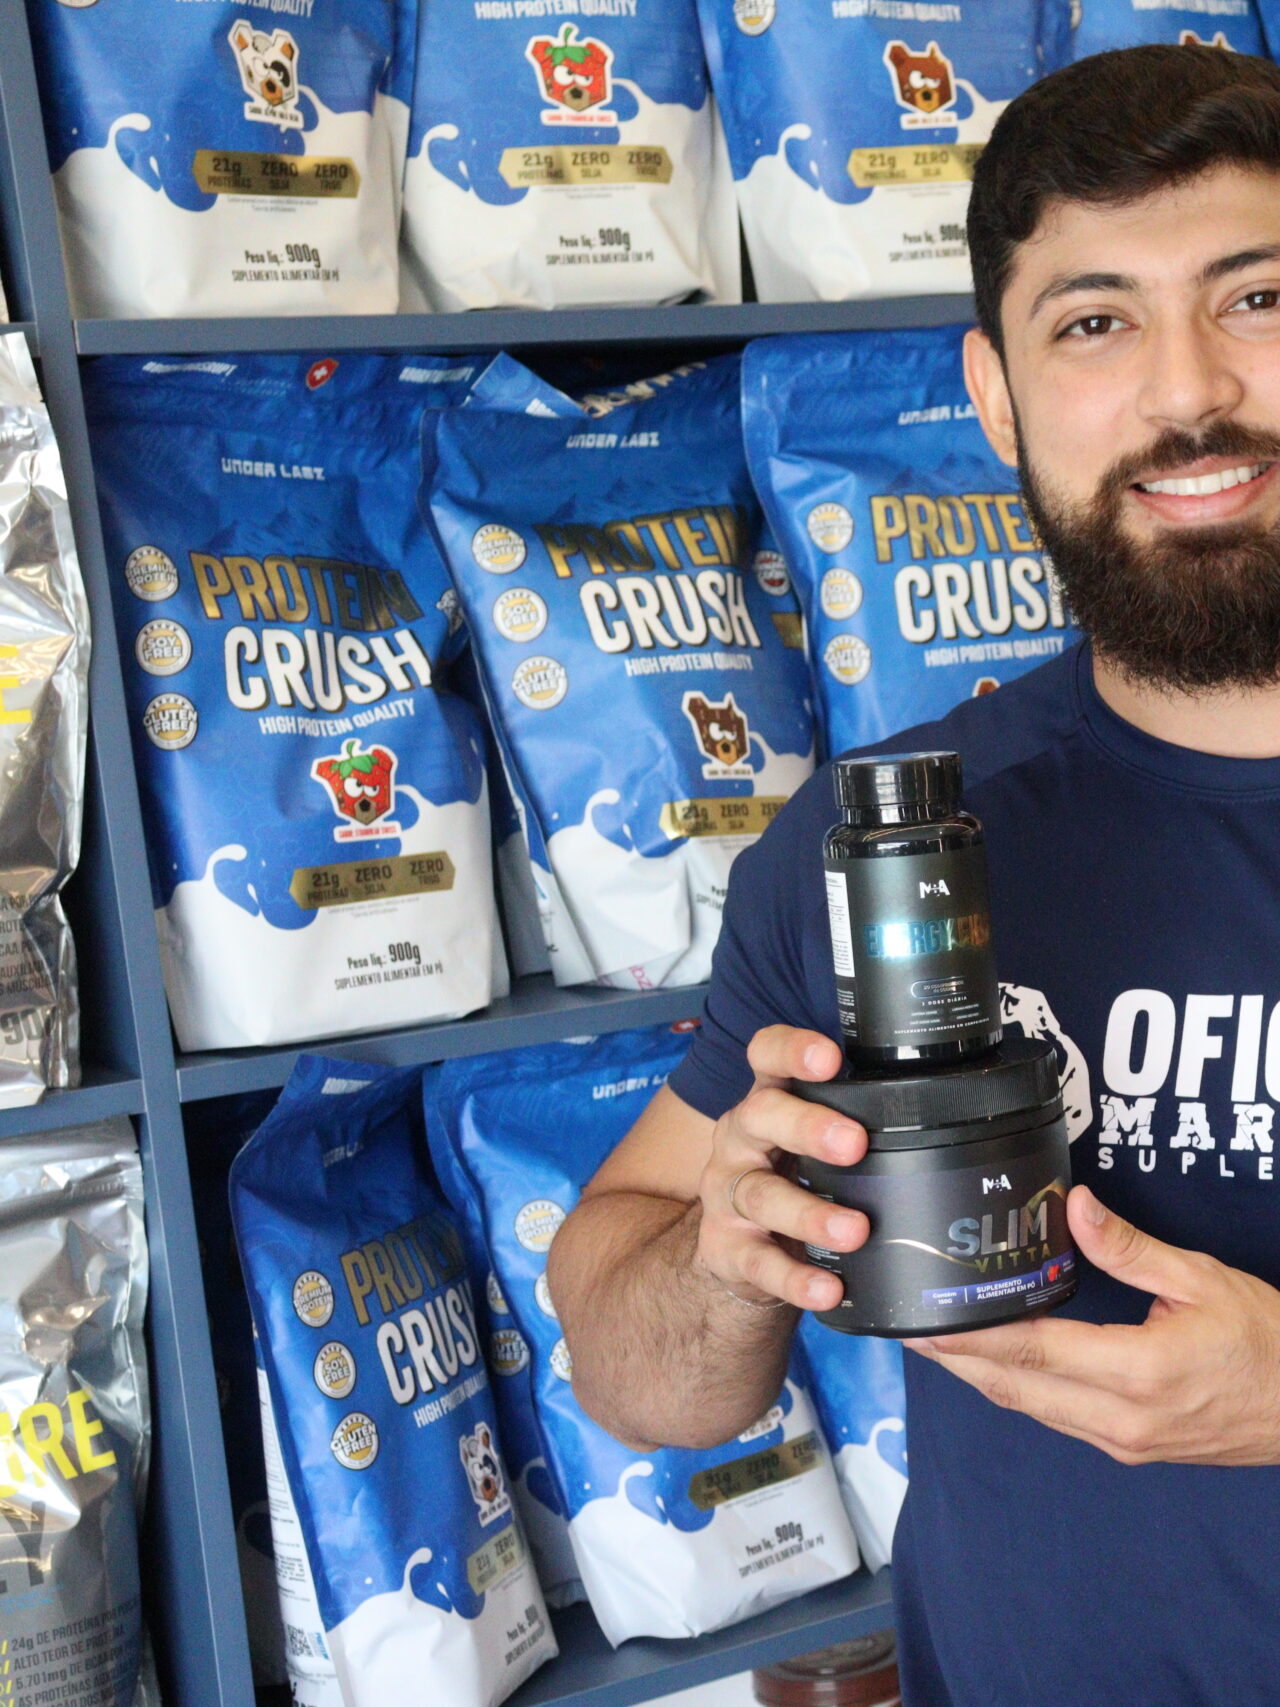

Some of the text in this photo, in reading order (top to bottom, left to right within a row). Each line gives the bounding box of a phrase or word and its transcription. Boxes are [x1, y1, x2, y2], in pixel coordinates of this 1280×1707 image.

[475, 1, 513, 19] HIGH
[212, 158, 349, 179] 21g ZERO ZERO
[522, 151, 663, 168] 21g ZERO ZERO
[868, 150, 949, 168] 21g ZERO
[599, 228, 631, 251] 900g
[285, 243, 321, 268] 900g
[566, 433, 617, 449] UNDER
[221, 457, 276, 478] UNDER
[870, 494, 1036, 563] PROTE
[532, 504, 747, 579] PROTEIN
[190, 551, 424, 632] PROTEIN
[504, 611, 539, 627] FREE
[579, 569, 761, 653] CRUSH
[147, 635, 177, 648] SOY
[144, 646, 182, 661] FREE
[924, 645, 960, 668] HIGH
[224, 626, 433, 713] CRUSH
[624, 658, 658, 677] HIGH
[658, 654, 713, 674] PROTEIN
[143, 709, 198, 727] GLUTEN
[153, 719, 192, 734] FREE
[258, 698, 416, 738] HIGH PROTEIN QUALITY
[721, 803, 749, 818] ZERO
[312, 859, 444, 889] 21g ZERO ZERO
[347, 956, 369, 970] Peso
[388, 941, 421, 965] 900g
[334, 973, 382, 990] SUPLEMENTO
[383, 967, 421, 983] ALIMENTAR
[592, 1077, 648, 1100] UNDER
[947, 1200, 1048, 1258] SLIM
[974, 1243, 1051, 1273] VITTA
[976, 1278, 1022, 1294] SUPLEMENTO
[977, 1287, 1016, 1300] ALIMENTAR
[1016, 1285, 1026, 1295] EM
[1026, 1281, 1036, 1291] PÓ
[324, 1357, 345, 1374] SOY
[324, 1366, 351, 1387] FREE
[413, 1402, 443, 1428] HIGH
[330, 1422, 376, 1452] GLUTEN
[344, 1434, 373, 1457] FREE
[775, 1521, 804, 1545] 900g
[12, 1615, 100, 1652] 24g DE PROTEÍNA
[14, 1640, 84, 1672] ALTO TEOR DE
[16, 1661, 83, 1690] 5.701mg DE
[35, 1678, 92, 1704] PROTEÍNAS
